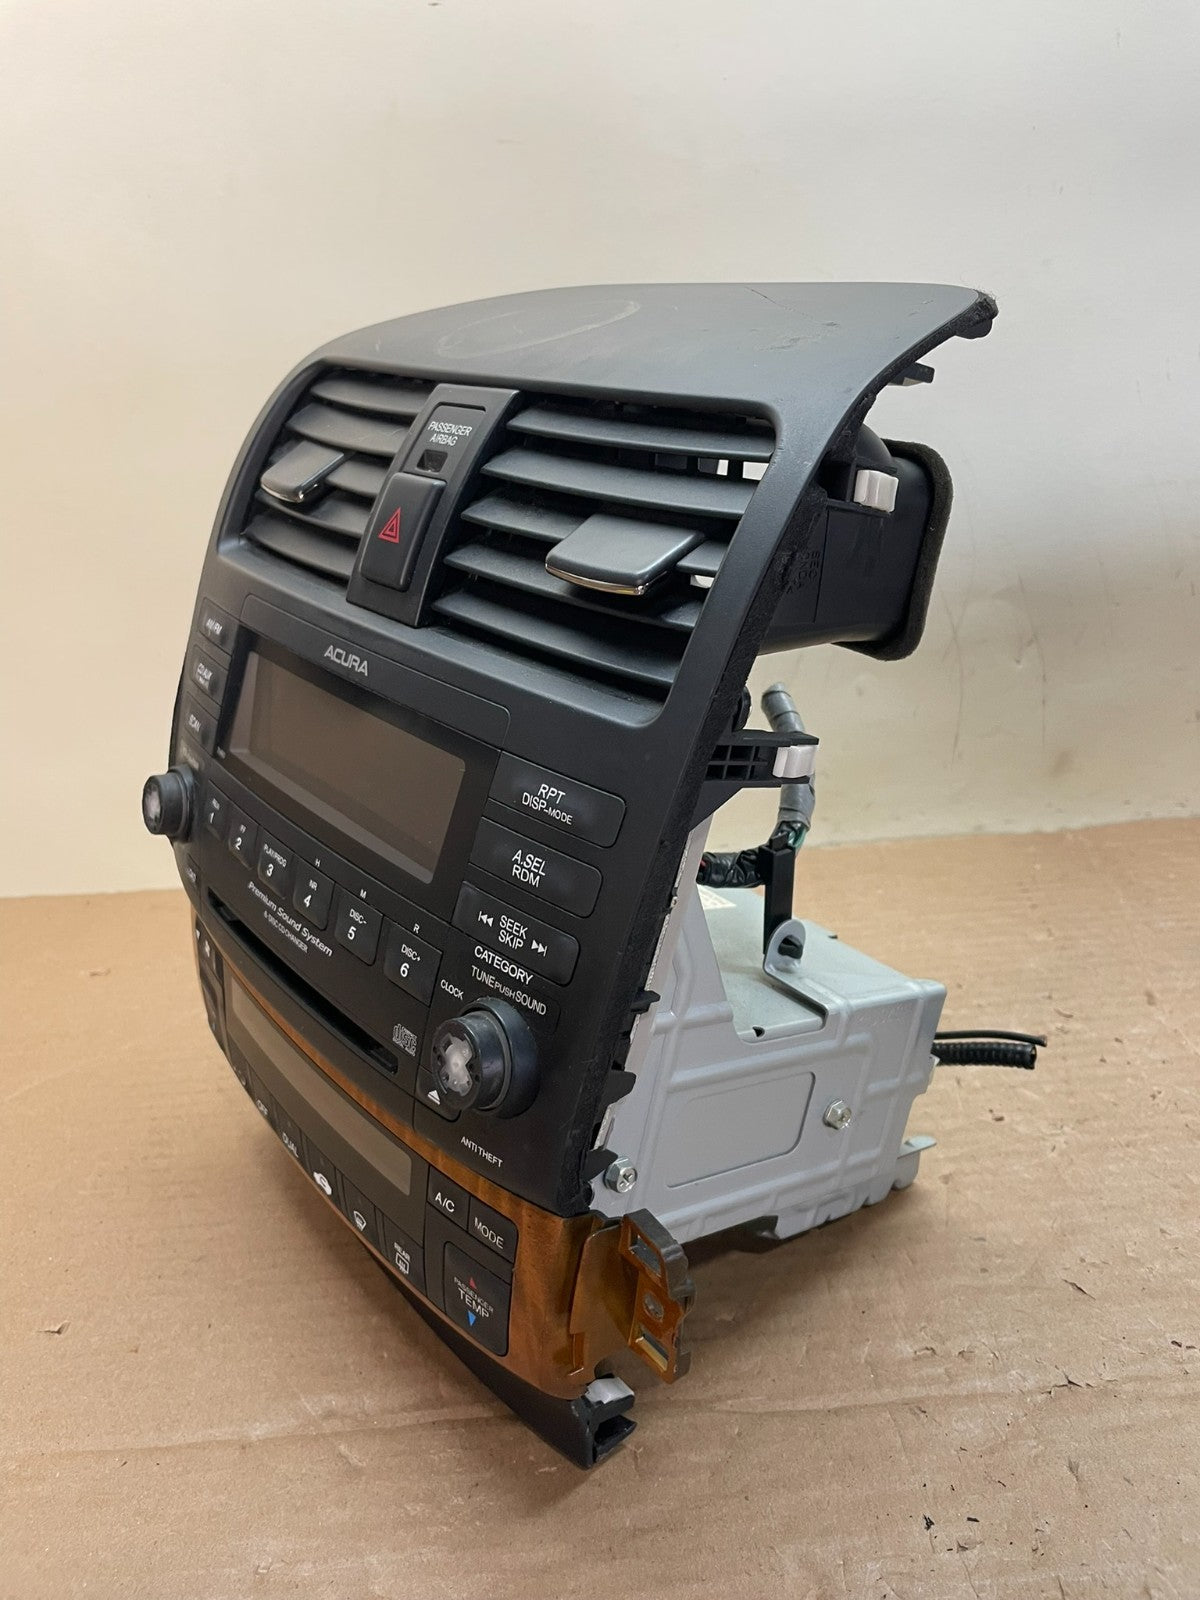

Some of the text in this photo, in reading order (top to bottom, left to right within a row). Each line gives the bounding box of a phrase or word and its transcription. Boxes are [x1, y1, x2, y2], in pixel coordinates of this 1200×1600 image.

[428, 421, 472, 437] PASSENGER
[430, 433, 458, 446] AIRBAG
[324, 644, 368, 677] ACURA
[537, 783, 566, 804] RPT
[210, 812, 214, 824] 1
[522, 792, 573, 825] DISP-MODE
[235, 837, 242, 851] 2
[266, 863, 274, 877] 3
[315, 859, 321, 868] H
[512, 849, 546, 876] A.SEL
[308, 879, 318, 891] NR
[512, 864, 540, 888] RDM
[303, 894, 312, 908] 4
[360, 889, 367, 899] M
[247, 881, 333, 957] Premium Sound System
[413, 923, 420, 934] R
[499, 915, 528, 939] SEEK
[347, 926, 357, 940] 5
[498, 929, 524, 950] SKIP
[400, 962, 410, 978] 6
[474, 945, 534, 985] CATEGORY
[440, 979, 464, 1001] CLOCK
[471, 965, 547, 1016] TUNE PUSH SOUND
[282, 1131, 299, 1158] DUAL
[477, 1147, 503, 1168] THEFT
[434, 1192, 455, 1213] A/C
[474, 1216, 504, 1250] MODE
[458, 1287, 490, 1318] TEMP
